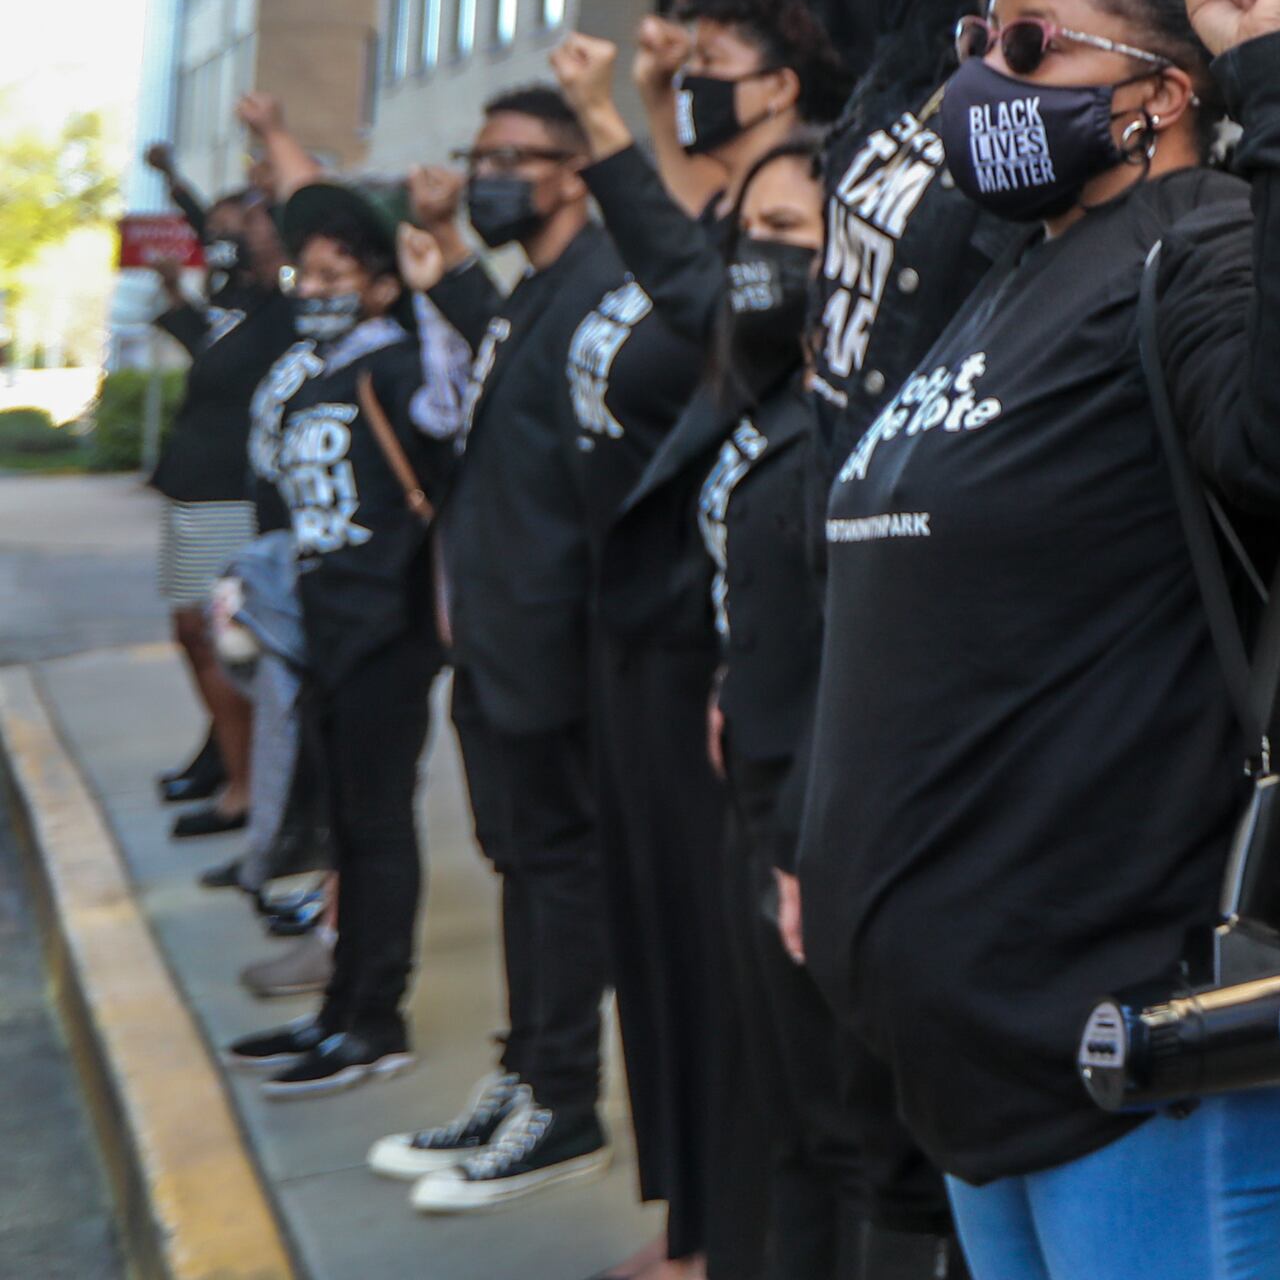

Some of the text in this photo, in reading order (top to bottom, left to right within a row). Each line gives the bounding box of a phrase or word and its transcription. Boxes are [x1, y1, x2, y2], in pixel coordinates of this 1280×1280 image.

[969, 95, 1042, 136] BLACK
[971, 125, 1048, 165] LIVES
[976, 157, 1056, 193] MATTER
